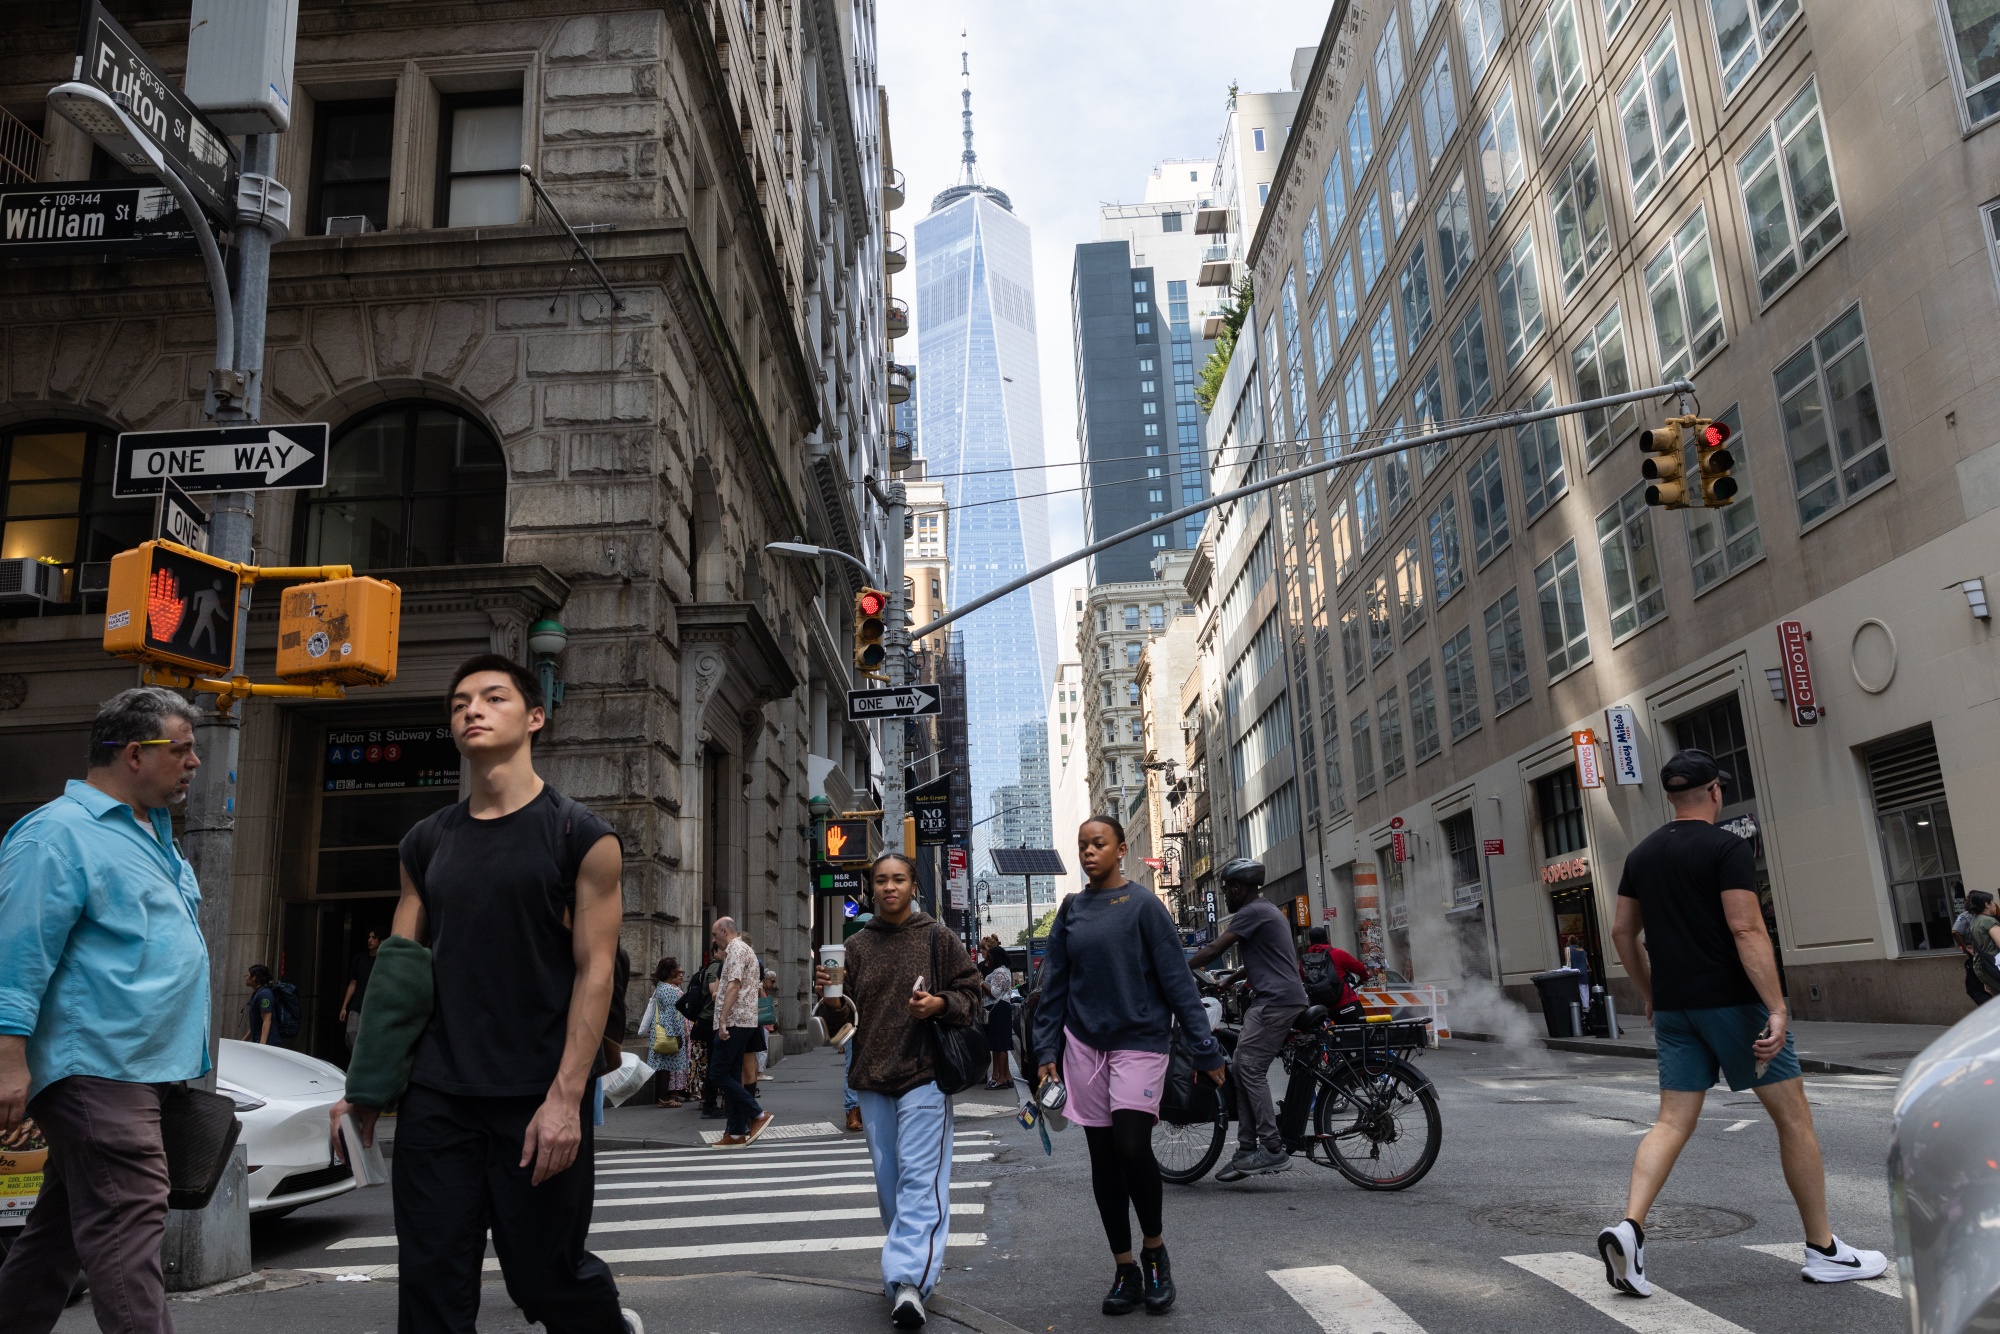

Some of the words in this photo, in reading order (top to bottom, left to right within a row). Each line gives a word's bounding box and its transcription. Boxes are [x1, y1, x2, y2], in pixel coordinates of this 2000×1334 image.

[97, 42, 167, 142] Fulton
[174, 119, 186, 142] St
[140, 68, 165, 100] 80-98
[56, 194, 100, 206] 108-144
[6, 207, 104, 239] William
[115, 205, 129, 220] St
[147, 450, 204, 474] ONE
[234, 446, 294, 470] WAY
[174, 510, 198, 550] ONE
[1788, 626, 1810, 700] CHIPOTLE
[858, 698, 883, 710] ONE
[895, 695, 922, 708] WAY
[329, 733, 364, 743] Fulton
[369, 732, 381, 742] St
[386, 730, 431, 741] Subway
[1614, 714, 1627, 743] Mike's
[332, 750, 341, 760] A
[351, 749, 360, 760] C
[371, 749, 378, 758] 2
[389, 748, 396, 757] 3
[1623, 745, 1635, 778] Jersey
[920, 818, 946, 828] FEE
[922, 809, 942, 818] NO
[1207, 893, 1215, 922] BAR
[1297, 898, 1305, 924] mezeh
